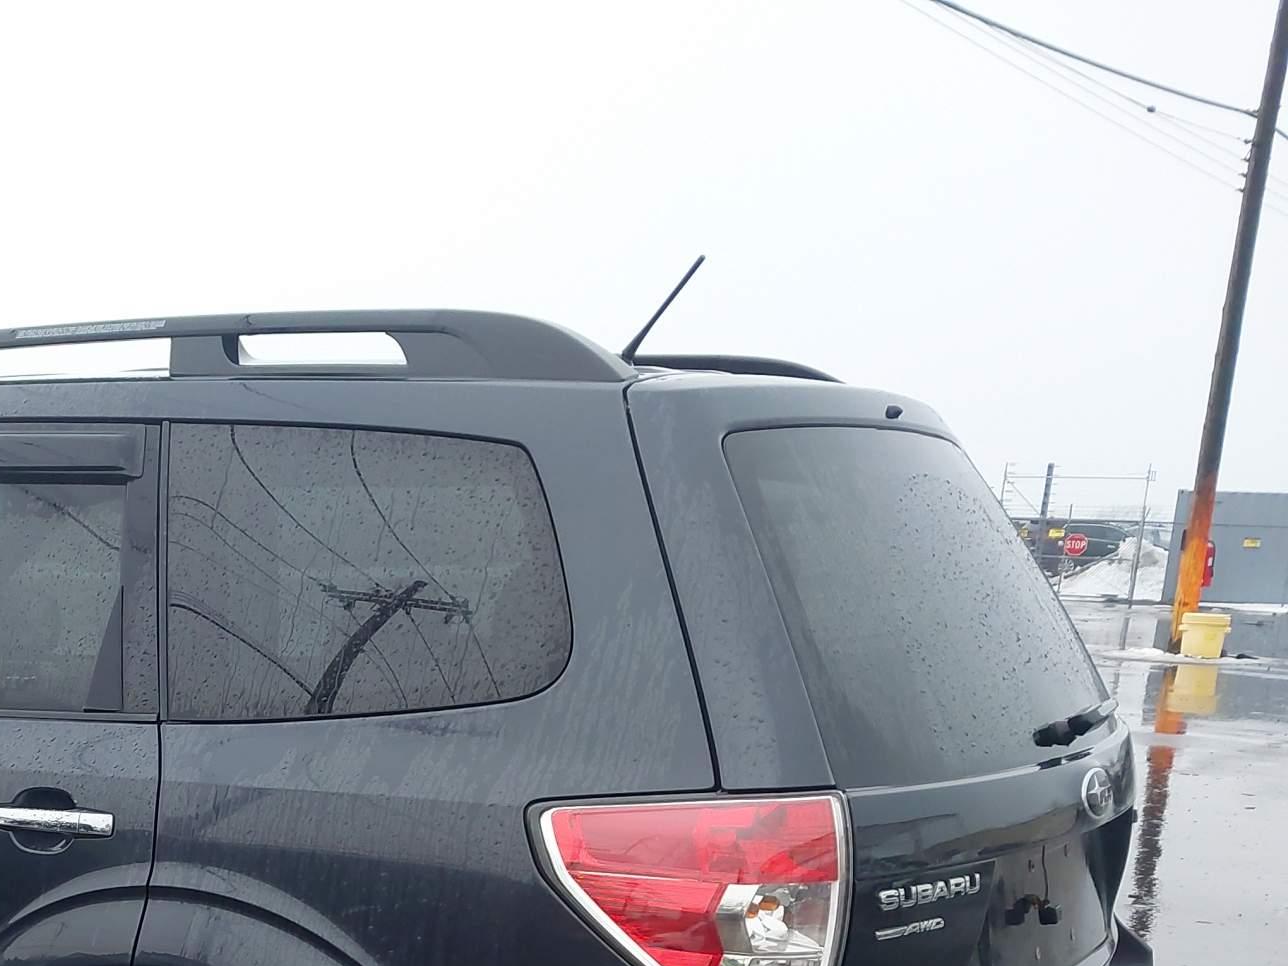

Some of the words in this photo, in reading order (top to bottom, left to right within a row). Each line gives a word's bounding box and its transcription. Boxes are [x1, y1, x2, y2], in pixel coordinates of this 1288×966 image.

[1066, 540, 1087, 549] STOP
[878, 873, 981, 911] SUBARU
[904, 918, 945, 936] AWD
